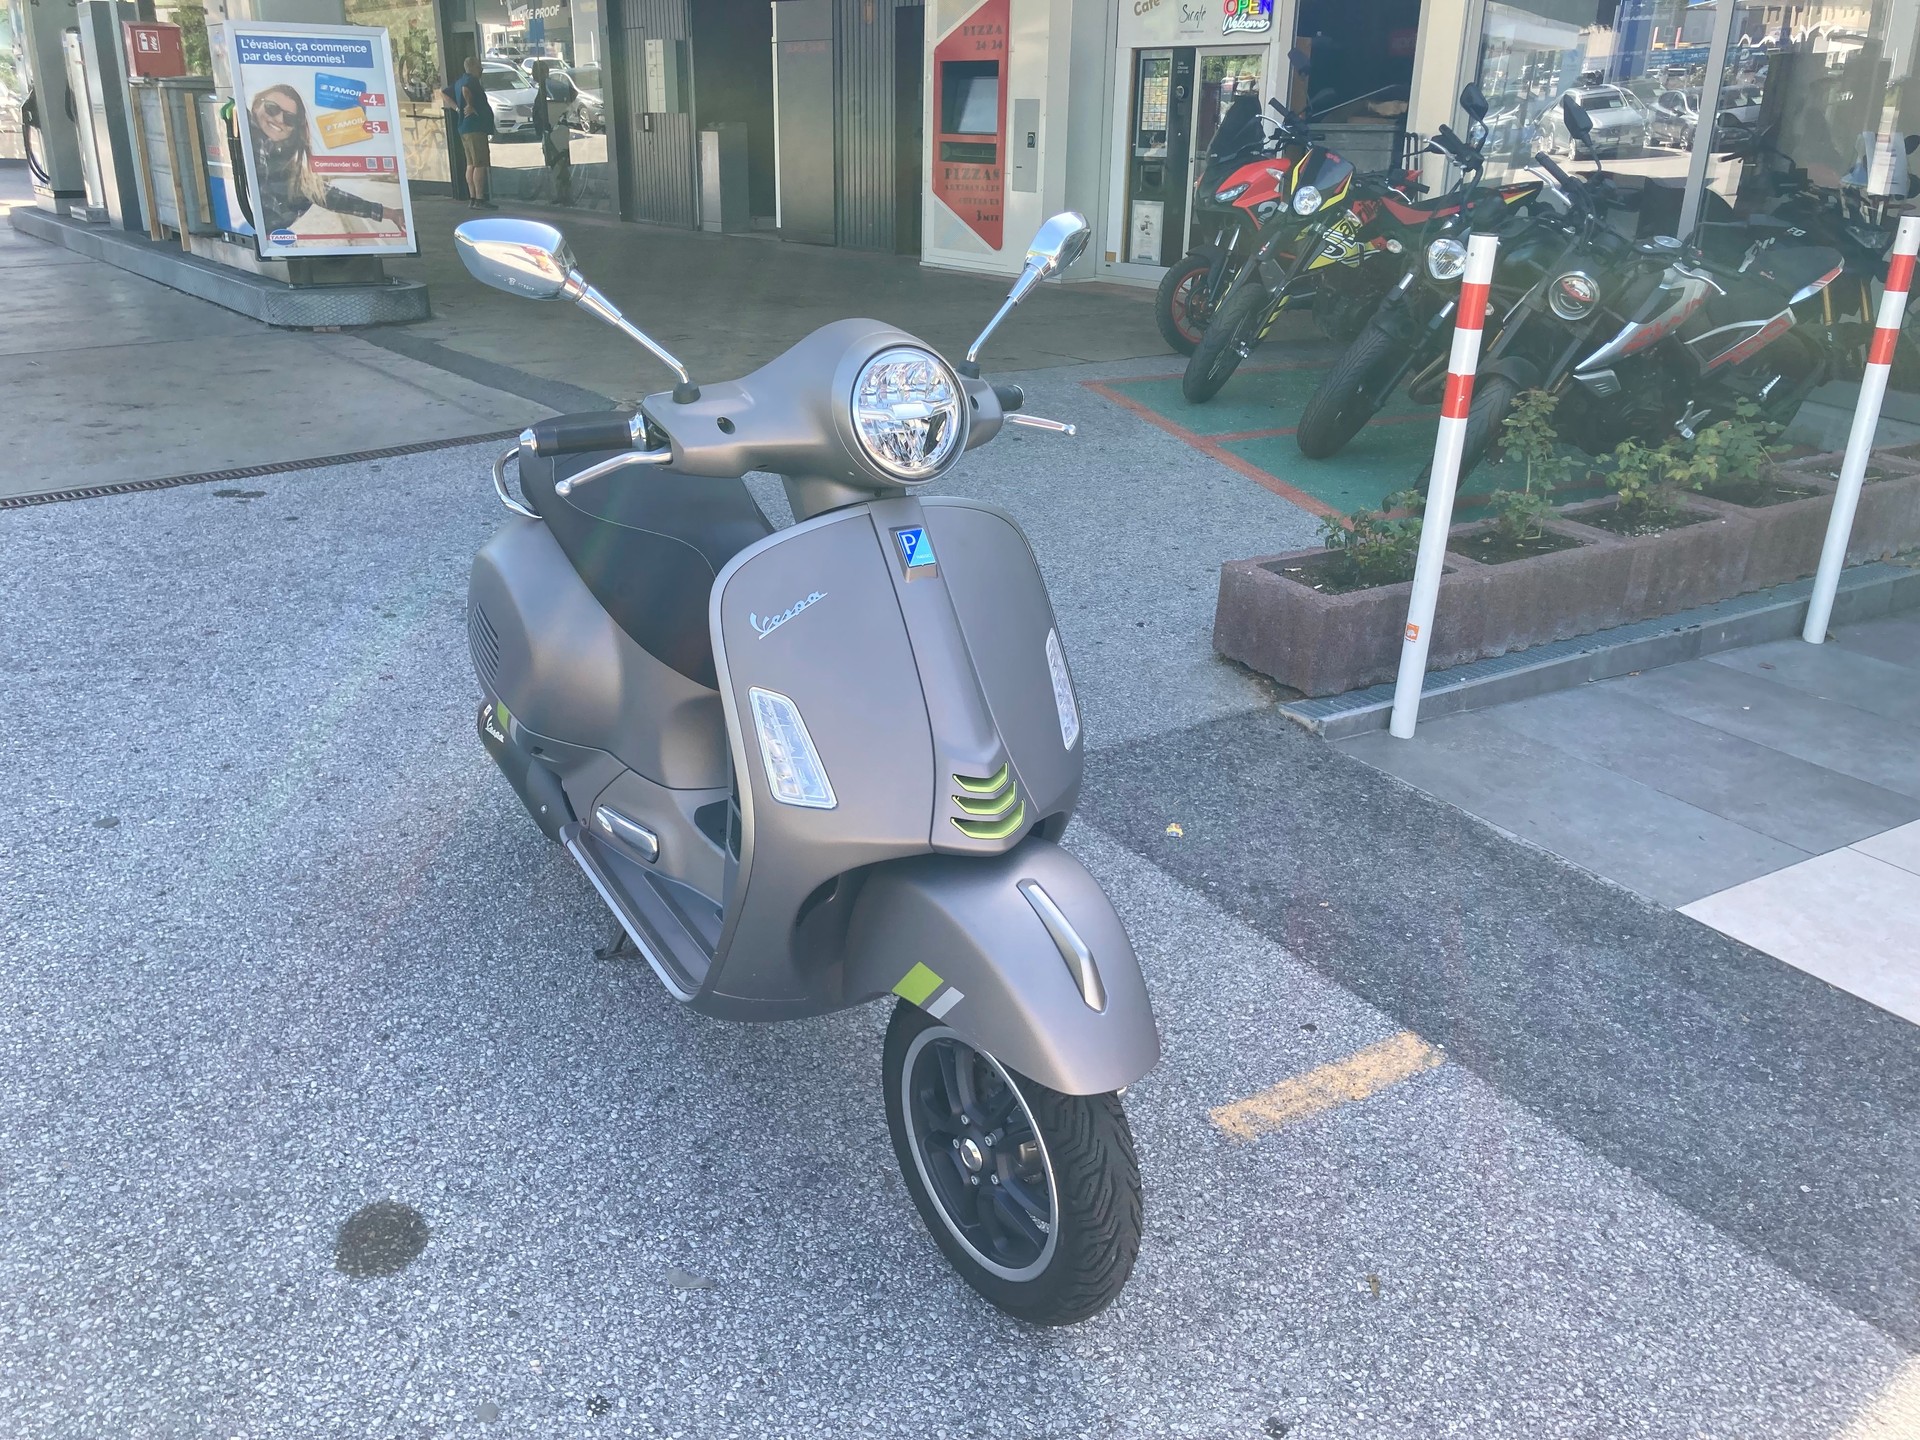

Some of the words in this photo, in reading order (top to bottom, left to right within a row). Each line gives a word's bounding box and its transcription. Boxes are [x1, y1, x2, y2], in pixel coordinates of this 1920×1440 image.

[535, 5, 560, 20] PROOF
[1224, 0, 1273, 16] OPEN
[963, 24, 1003, 36] PIZZA
[1222, 13, 1270, 36] Welcome
[240, 39, 294, 52] L'évasion,
[295, 42, 309, 53] ça
[310, 43, 368, 54] commence
[242, 52, 260, 63] par
[263, 51, 283, 62] des
[363, 94, 378, 106] -4
[367, 121, 381, 133] -5
[944, 168, 1000, 180] PIZZAS
[901, 533, 917, 555] P
[750, 590, 828, 640] Vespa
